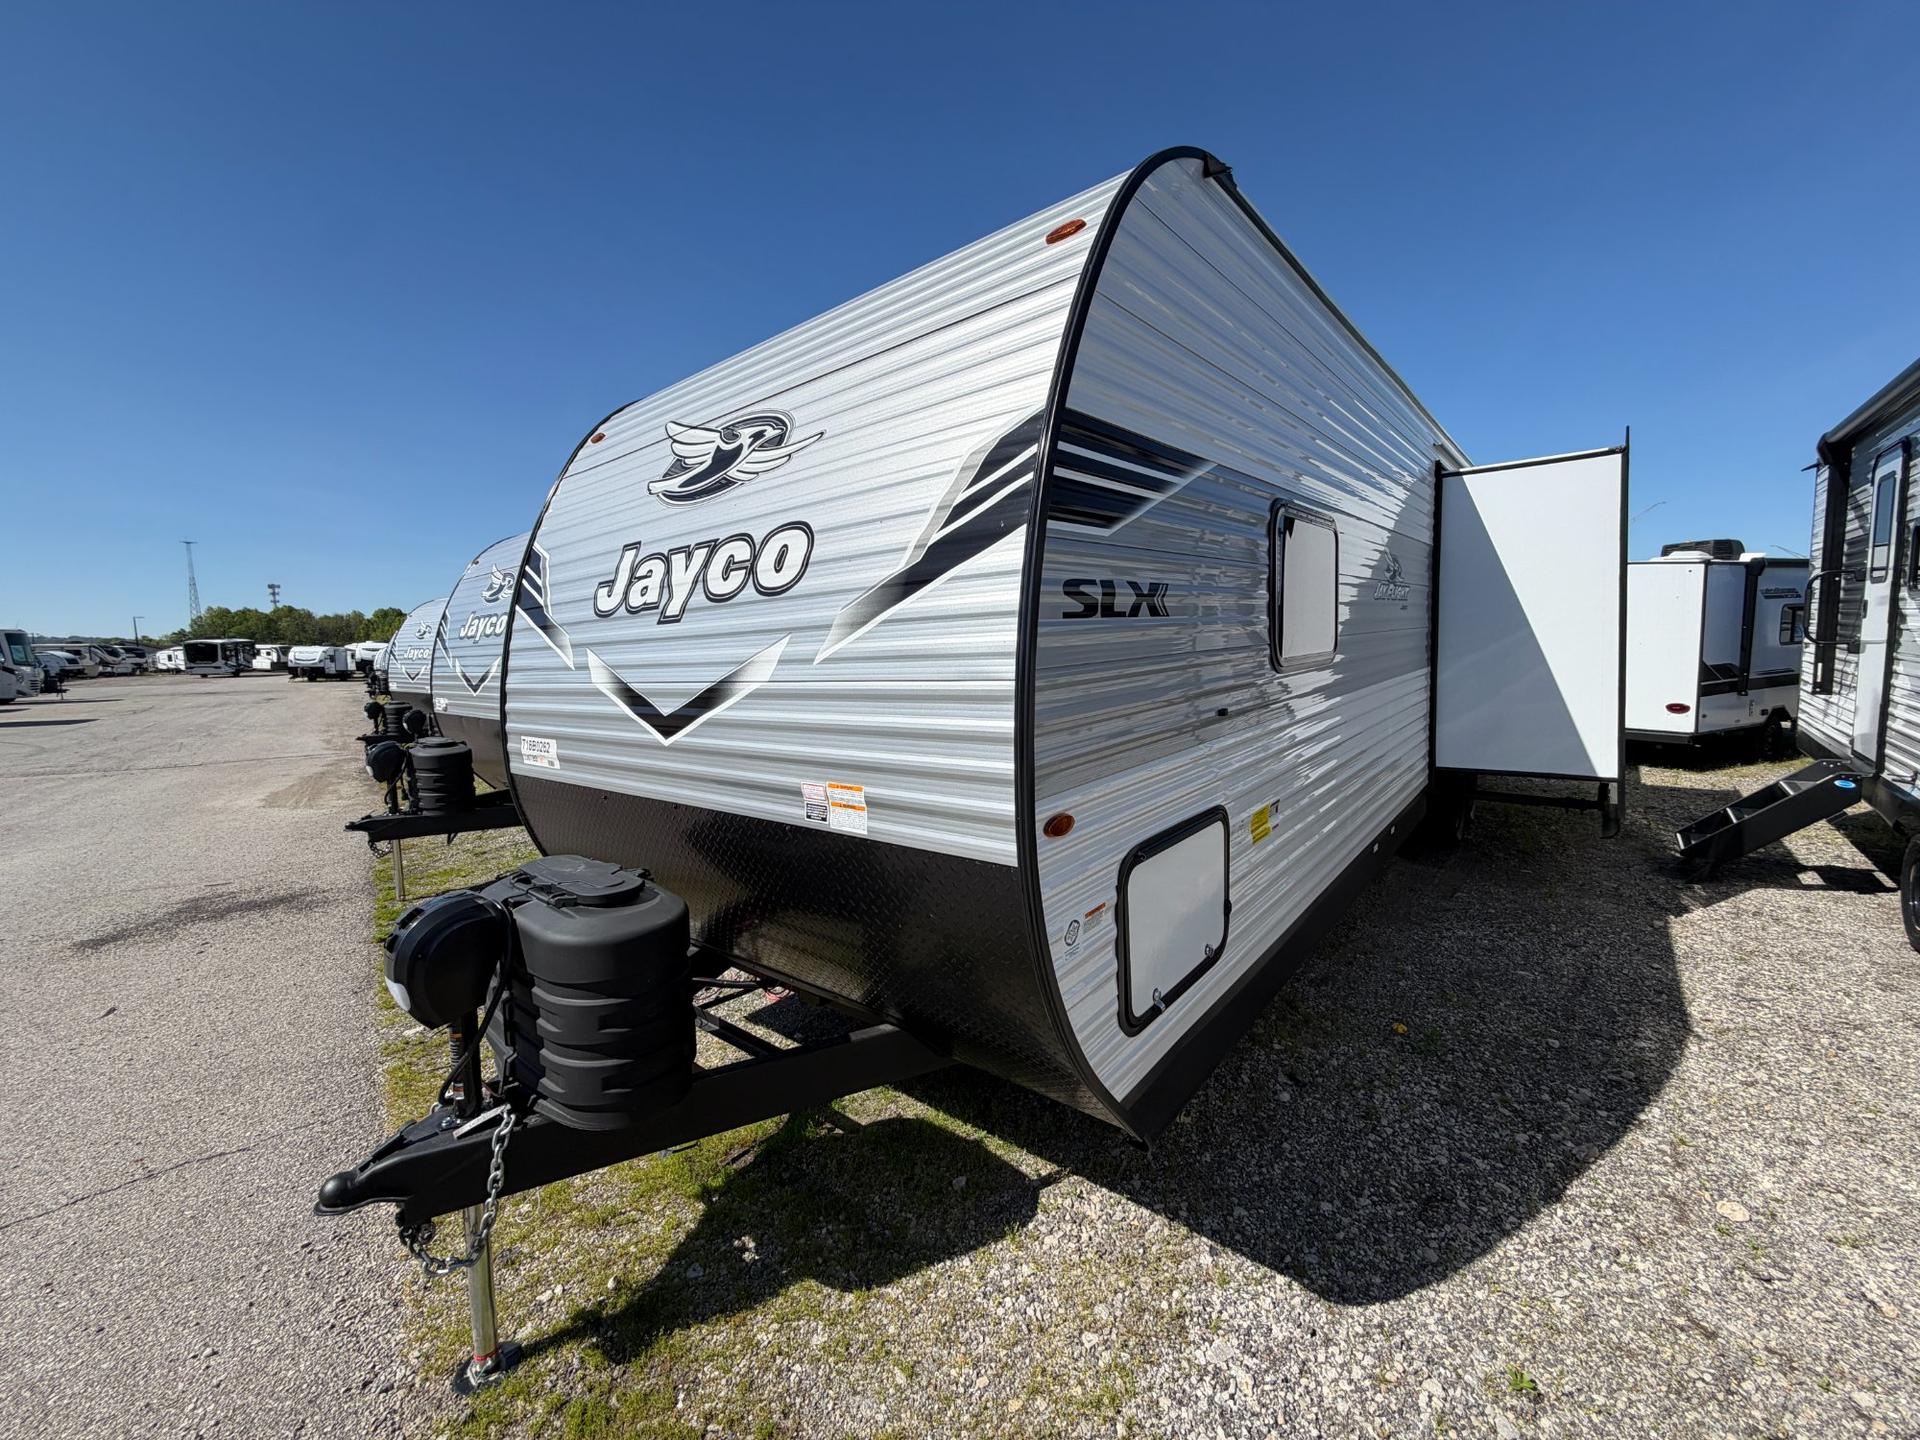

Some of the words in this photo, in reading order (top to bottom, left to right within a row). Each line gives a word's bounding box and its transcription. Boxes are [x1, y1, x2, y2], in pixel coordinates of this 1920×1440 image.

[594, 520, 815, 625] Jayco
[1062, 578, 1170, 619] SLX
[459, 611, 508, 644] Jayco
[404, 645, 430, 661] Jayco
